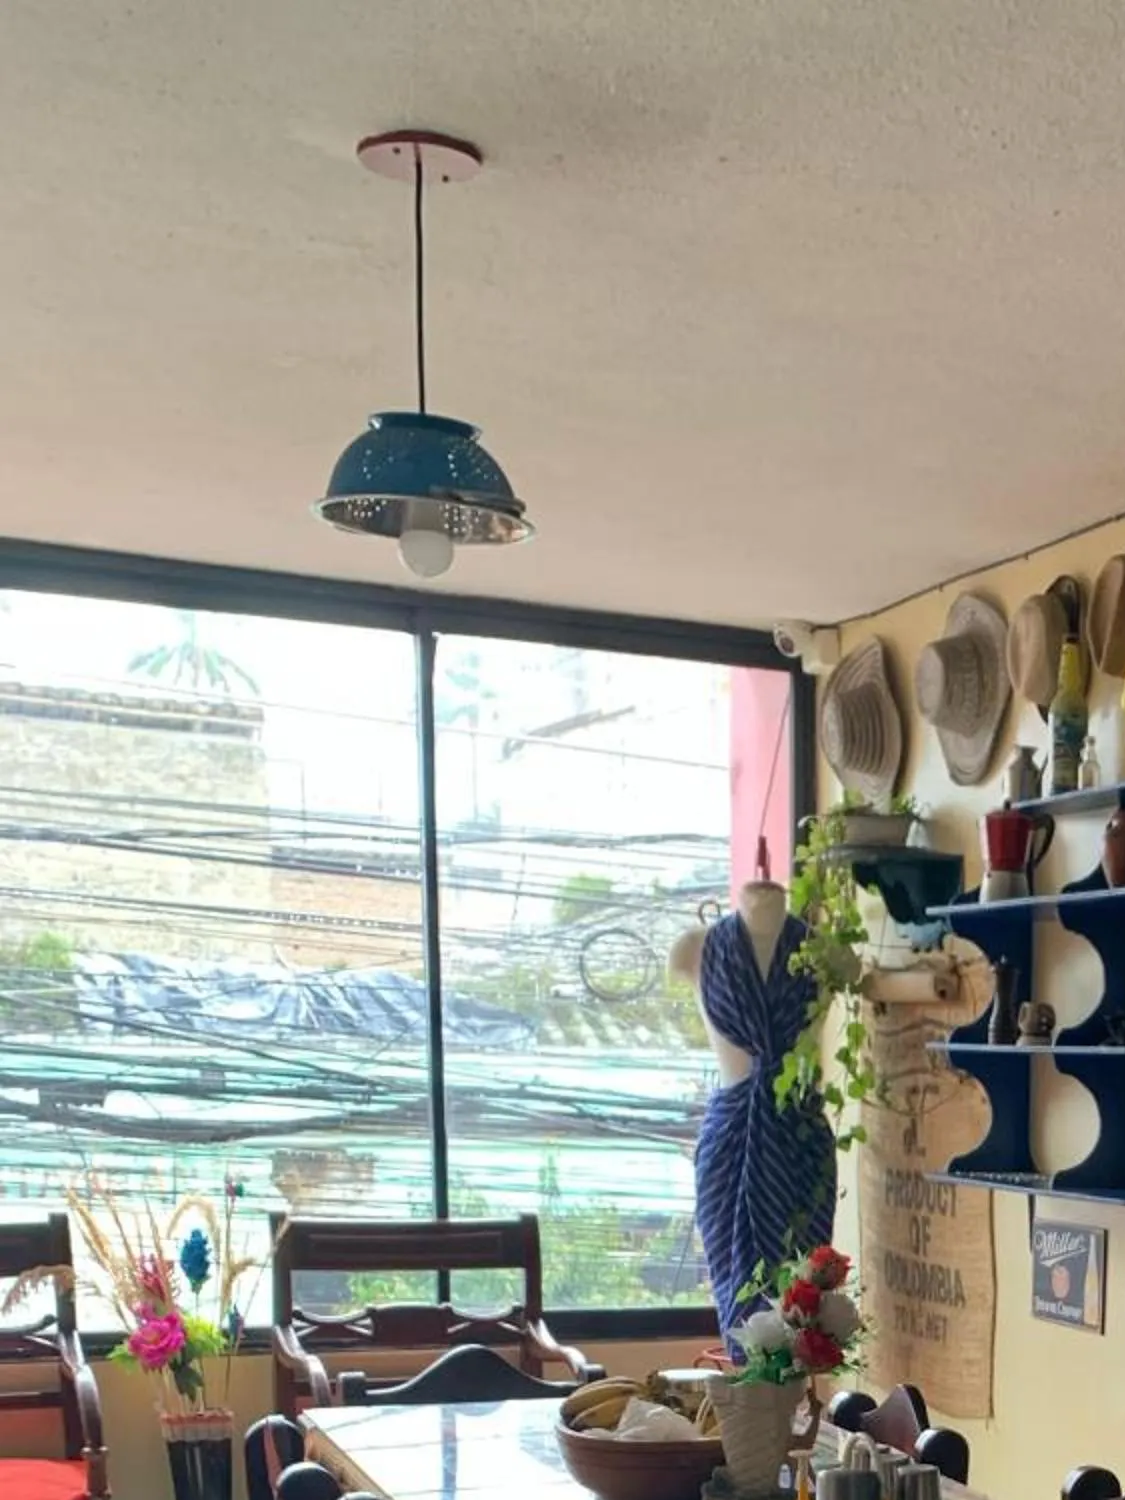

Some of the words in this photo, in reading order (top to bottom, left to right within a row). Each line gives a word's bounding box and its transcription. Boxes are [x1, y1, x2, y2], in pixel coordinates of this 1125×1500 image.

[885, 1168, 958, 1218] PRODUCT
[909, 1214, 932, 1257] OF
[884, 1250, 967, 1309] COLOMBIA
